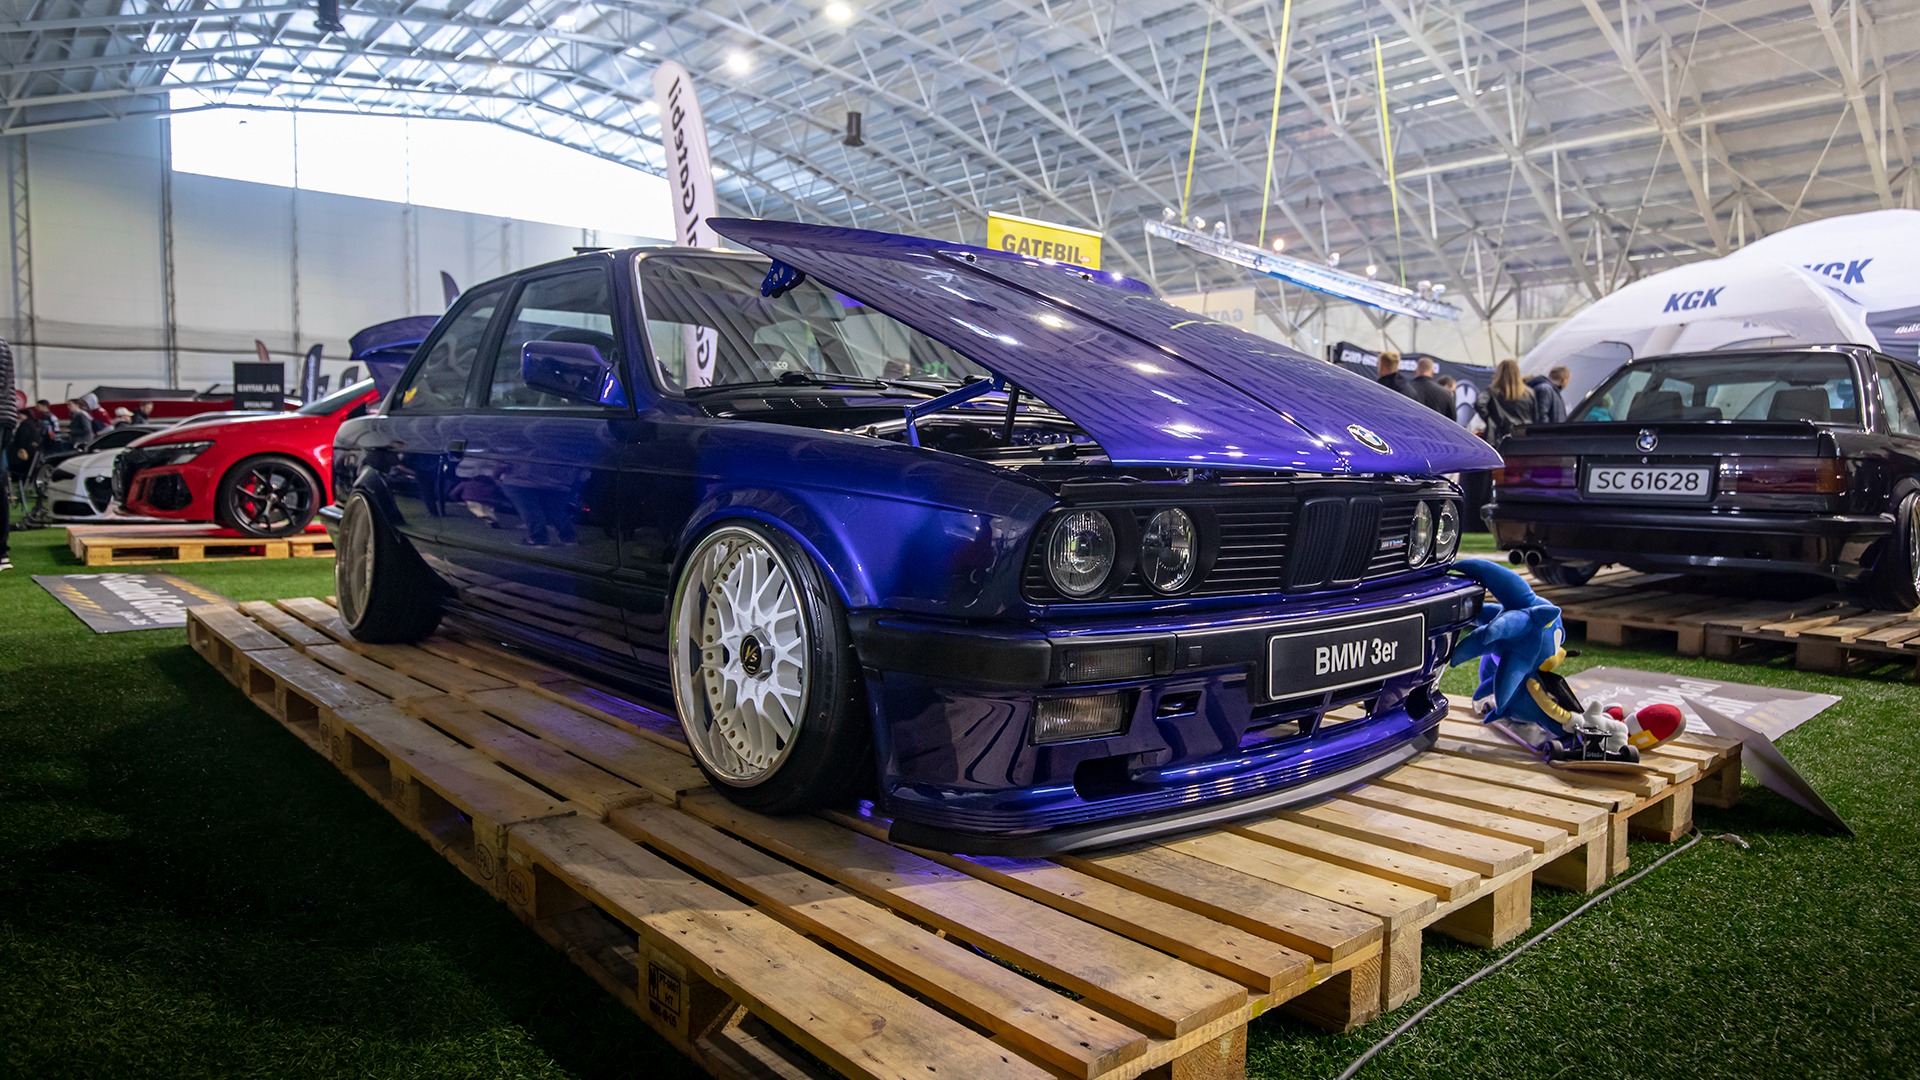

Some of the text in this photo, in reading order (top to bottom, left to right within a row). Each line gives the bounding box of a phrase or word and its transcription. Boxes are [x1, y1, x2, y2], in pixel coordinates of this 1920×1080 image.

[1002, 233, 1082, 264] GATEBIL
[1663, 286, 1726, 313] KGK
[1596, 470, 1700, 492] SC 61628
[1314, 637, 1398, 675] BMW 3er
